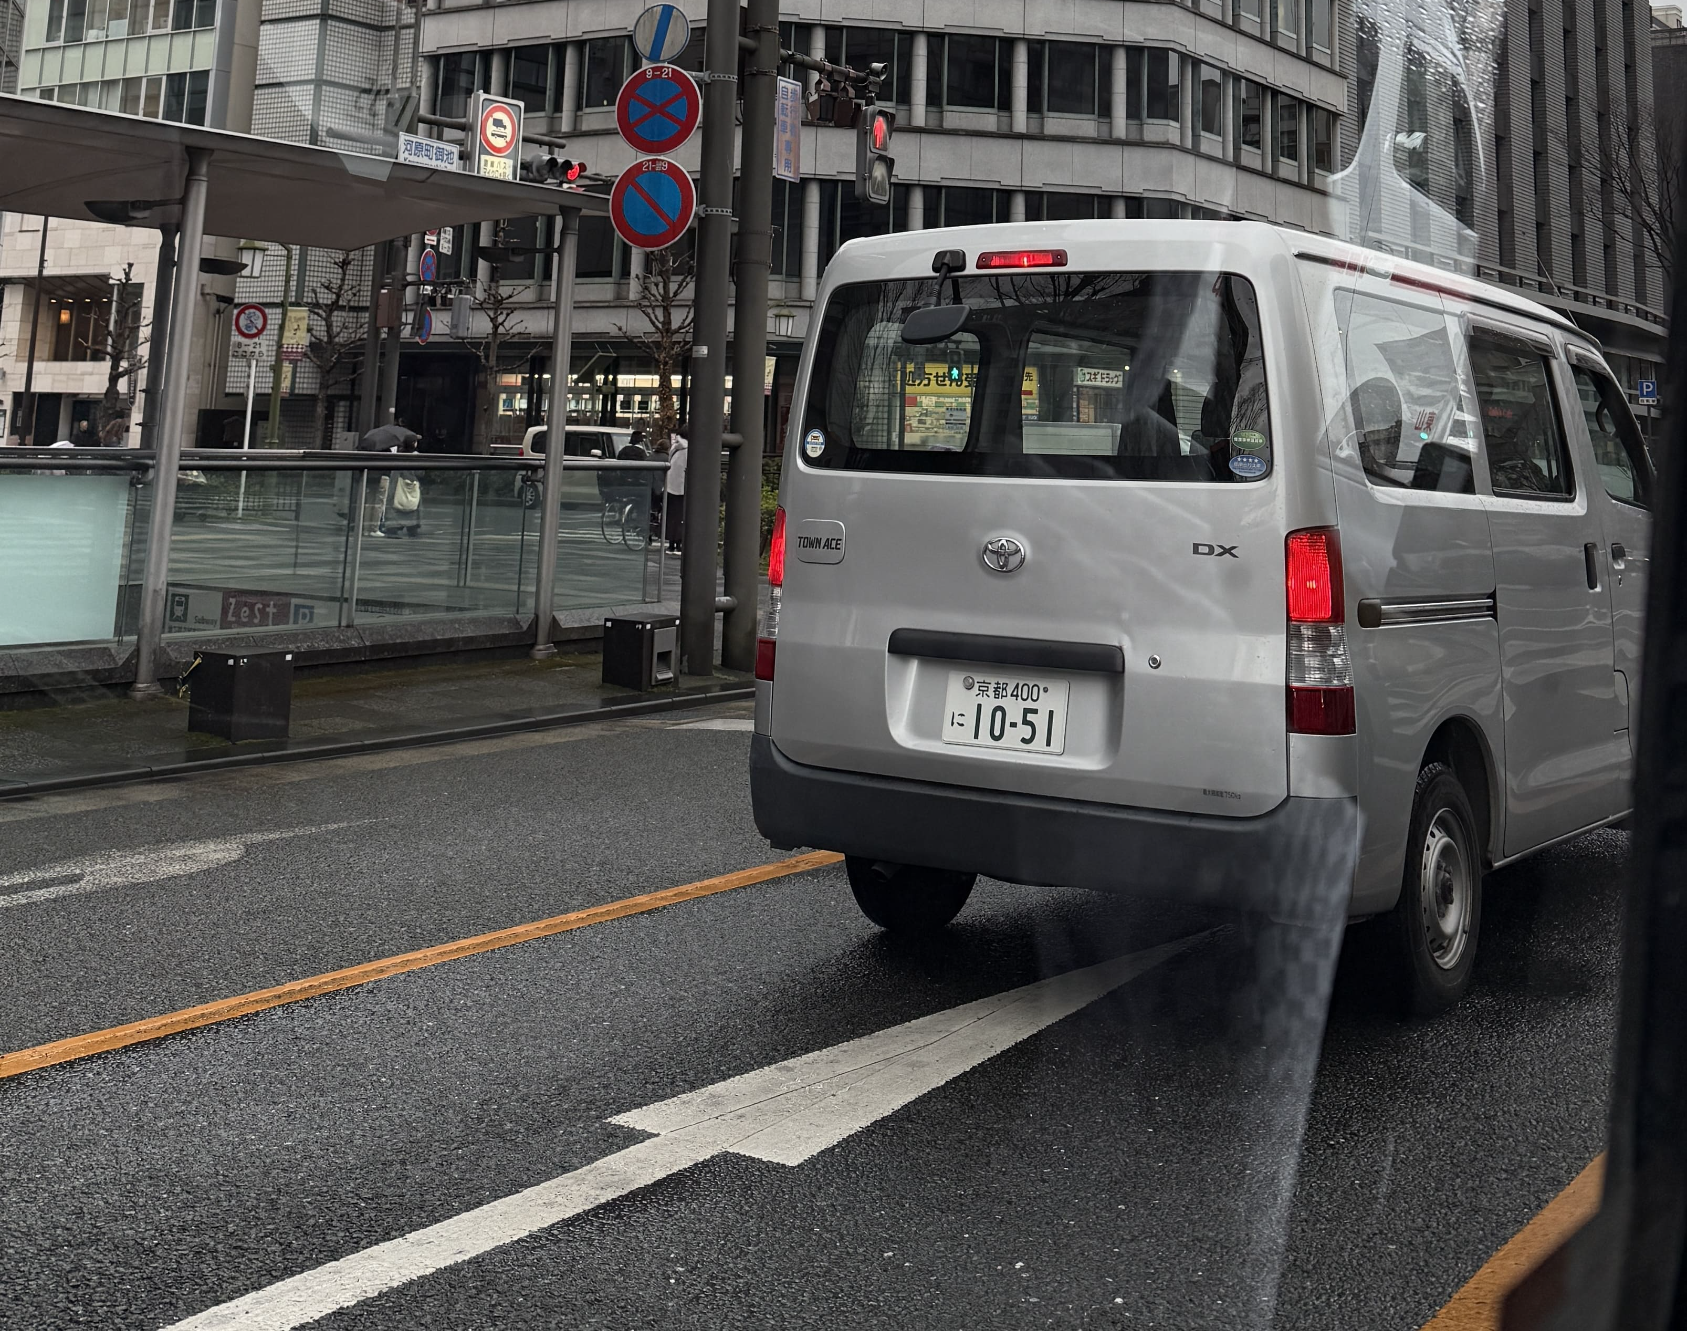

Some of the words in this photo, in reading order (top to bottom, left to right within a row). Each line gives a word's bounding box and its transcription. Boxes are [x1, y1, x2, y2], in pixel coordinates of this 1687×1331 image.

[646, 68, 672, 79] 9-21
[402, 138, 455, 165] 河原町御池
[1643, 382, 1654, 396] P
[797, 535, 822, 551] TOWN
[823, 537, 842, 551] ACE
[1192, 542, 1239, 559] DX
[194, 615, 218, 627] Subway
[951, 710, 966, 728] に
[973, 703, 1055, 747] 10-51
